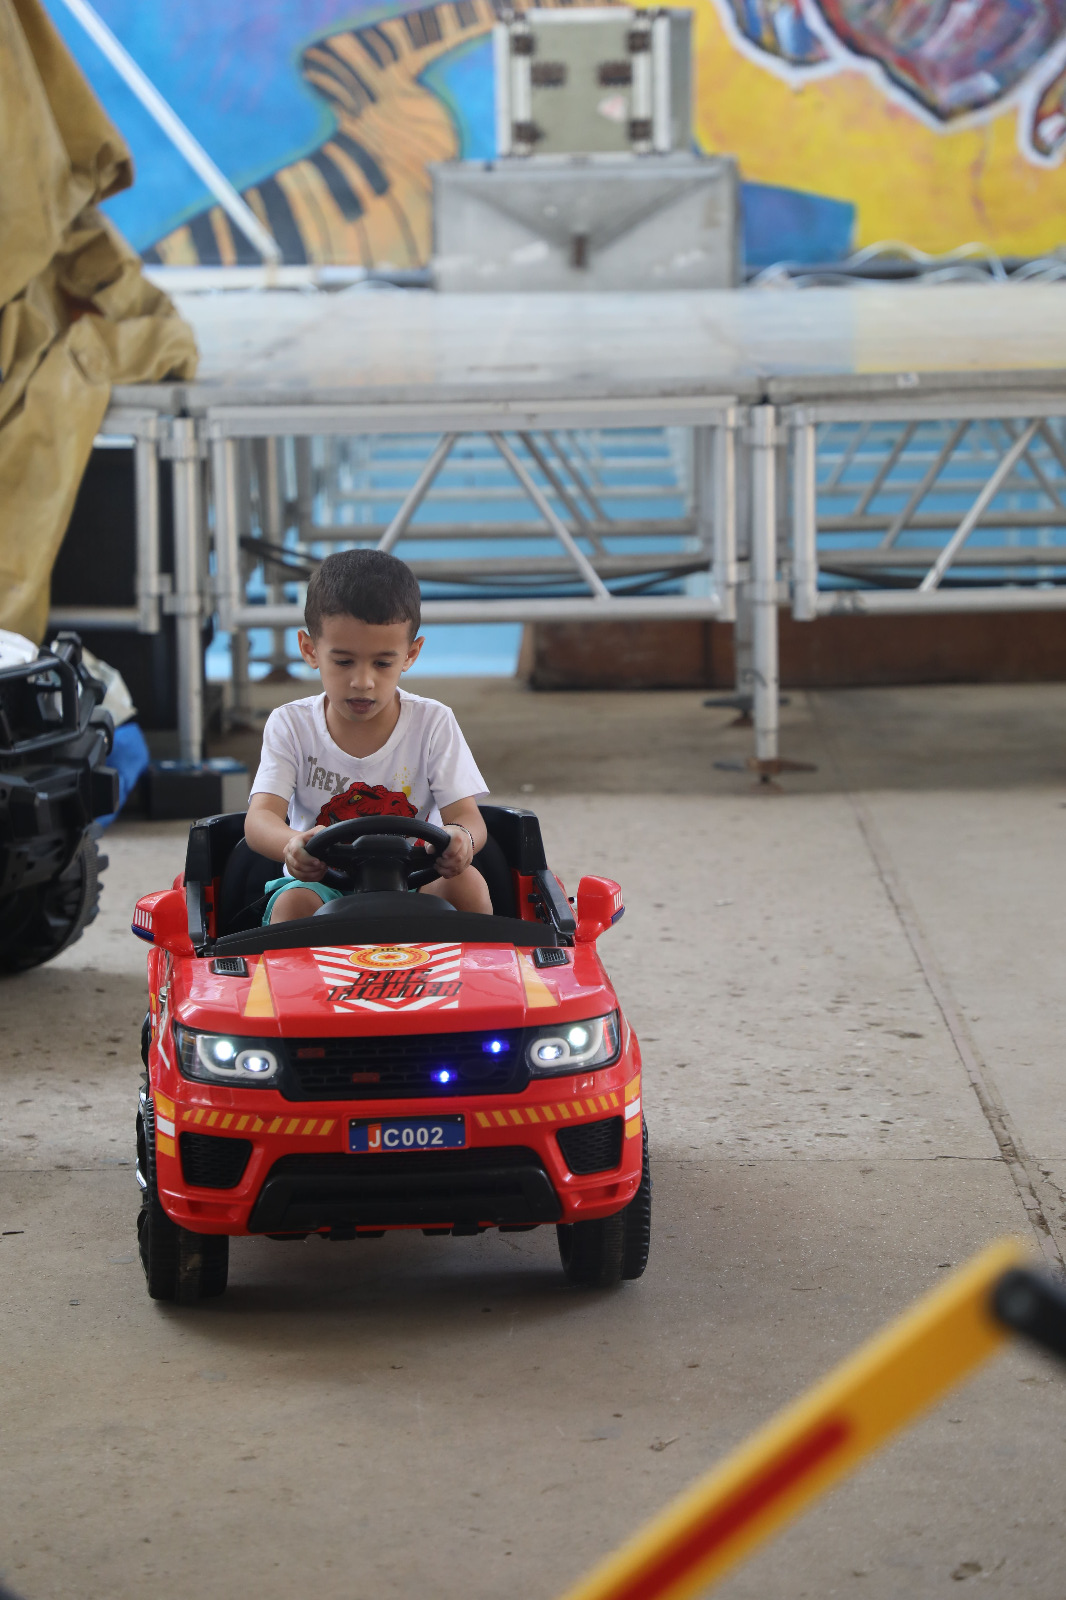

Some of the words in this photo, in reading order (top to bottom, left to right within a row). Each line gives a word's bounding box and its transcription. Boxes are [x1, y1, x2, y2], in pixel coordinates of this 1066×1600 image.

[354, 969, 433, 985] FIRE
[327, 981, 462, 1001] FIGHTER
[368, 1127, 444, 1148] JC002
